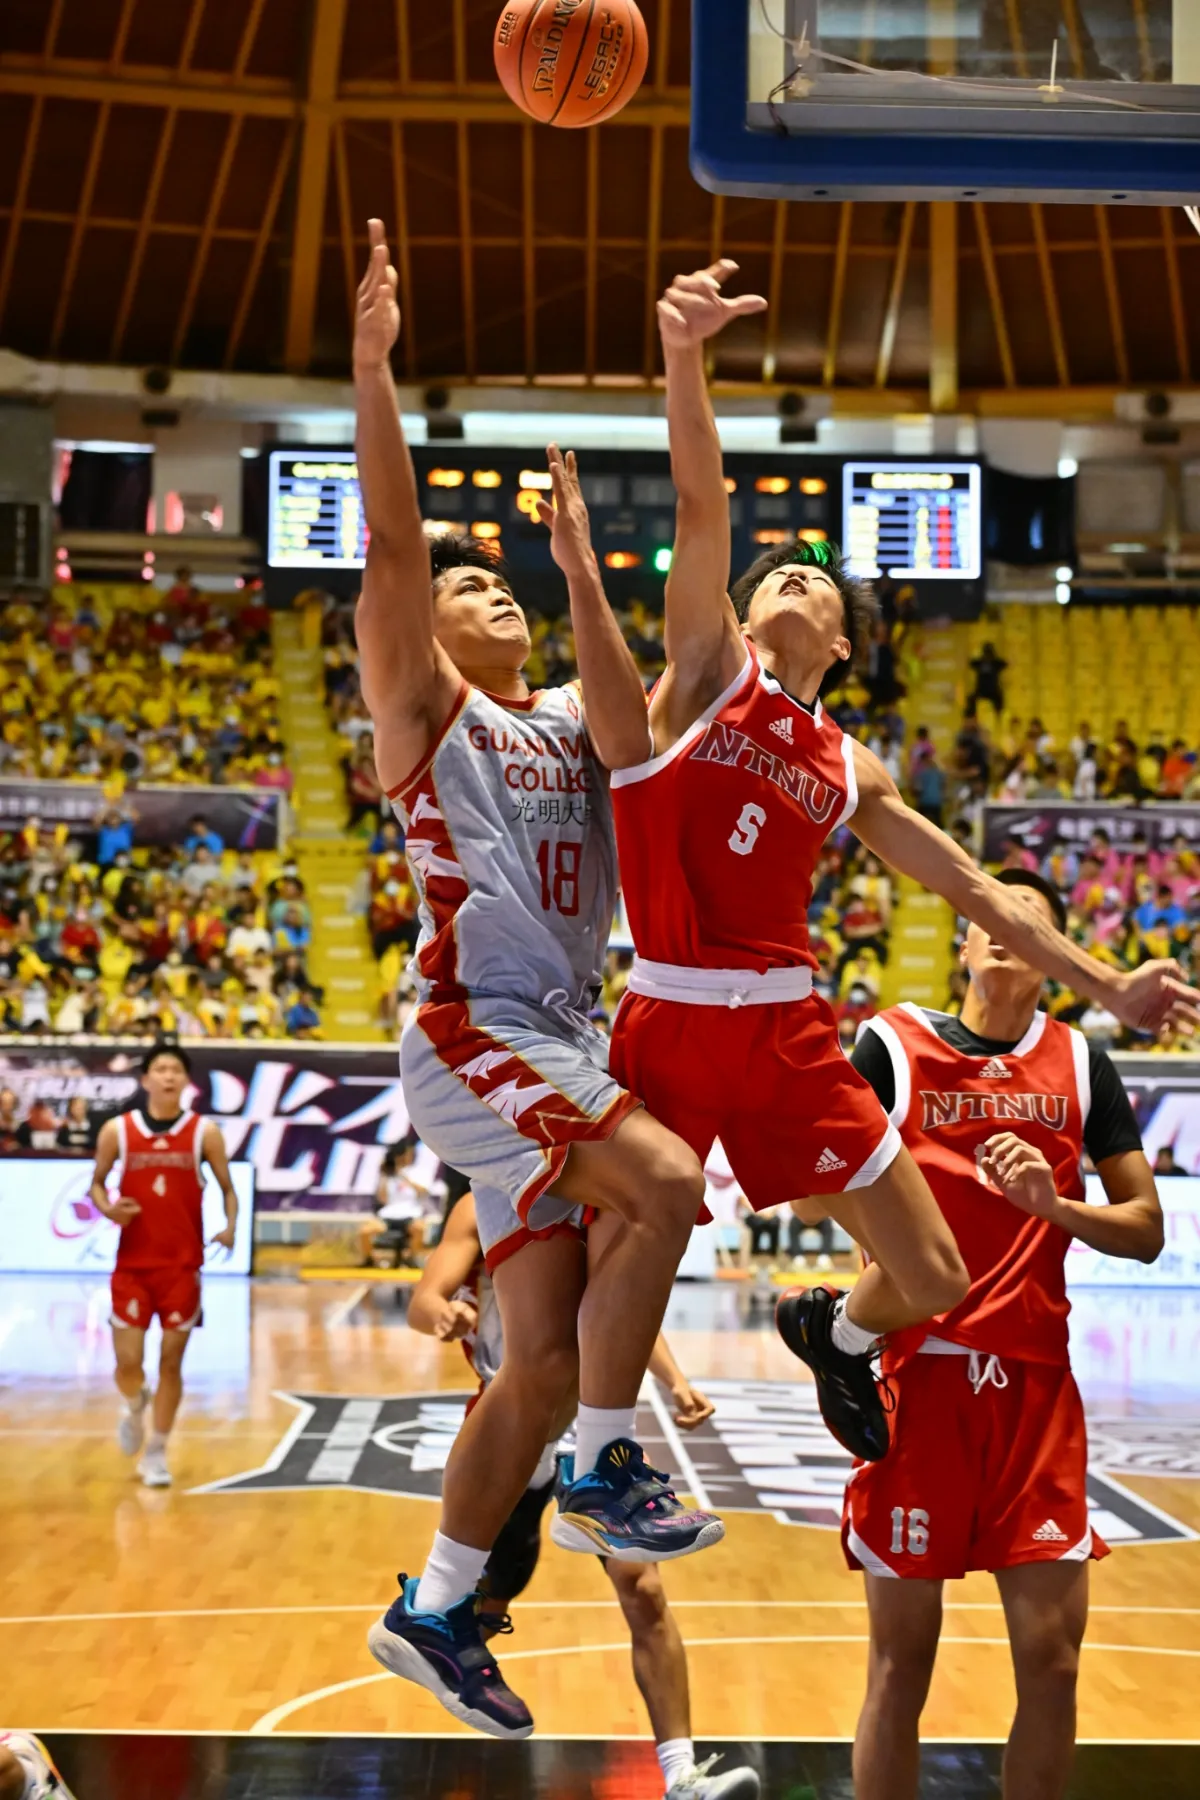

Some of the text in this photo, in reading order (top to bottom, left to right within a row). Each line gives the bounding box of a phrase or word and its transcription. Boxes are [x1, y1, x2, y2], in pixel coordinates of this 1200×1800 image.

[498, 11, 514, 46] FIBA
[577, 8, 615, 101] LEGACY
[768, 722, 795, 746] adidas
[689, 719, 840, 824] NTNU
[536, 840, 582, 917] 18
[978, 1070, 1013, 1079] adidas
[918, 1090, 1069, 1131] NTNU
[814, 1159, 848, 1174] adidas
[152, 1174, 167, 1197] 4
[889, 1506, 930, 1556] 16
[1032, 1533, 1069, 1541] adidas
